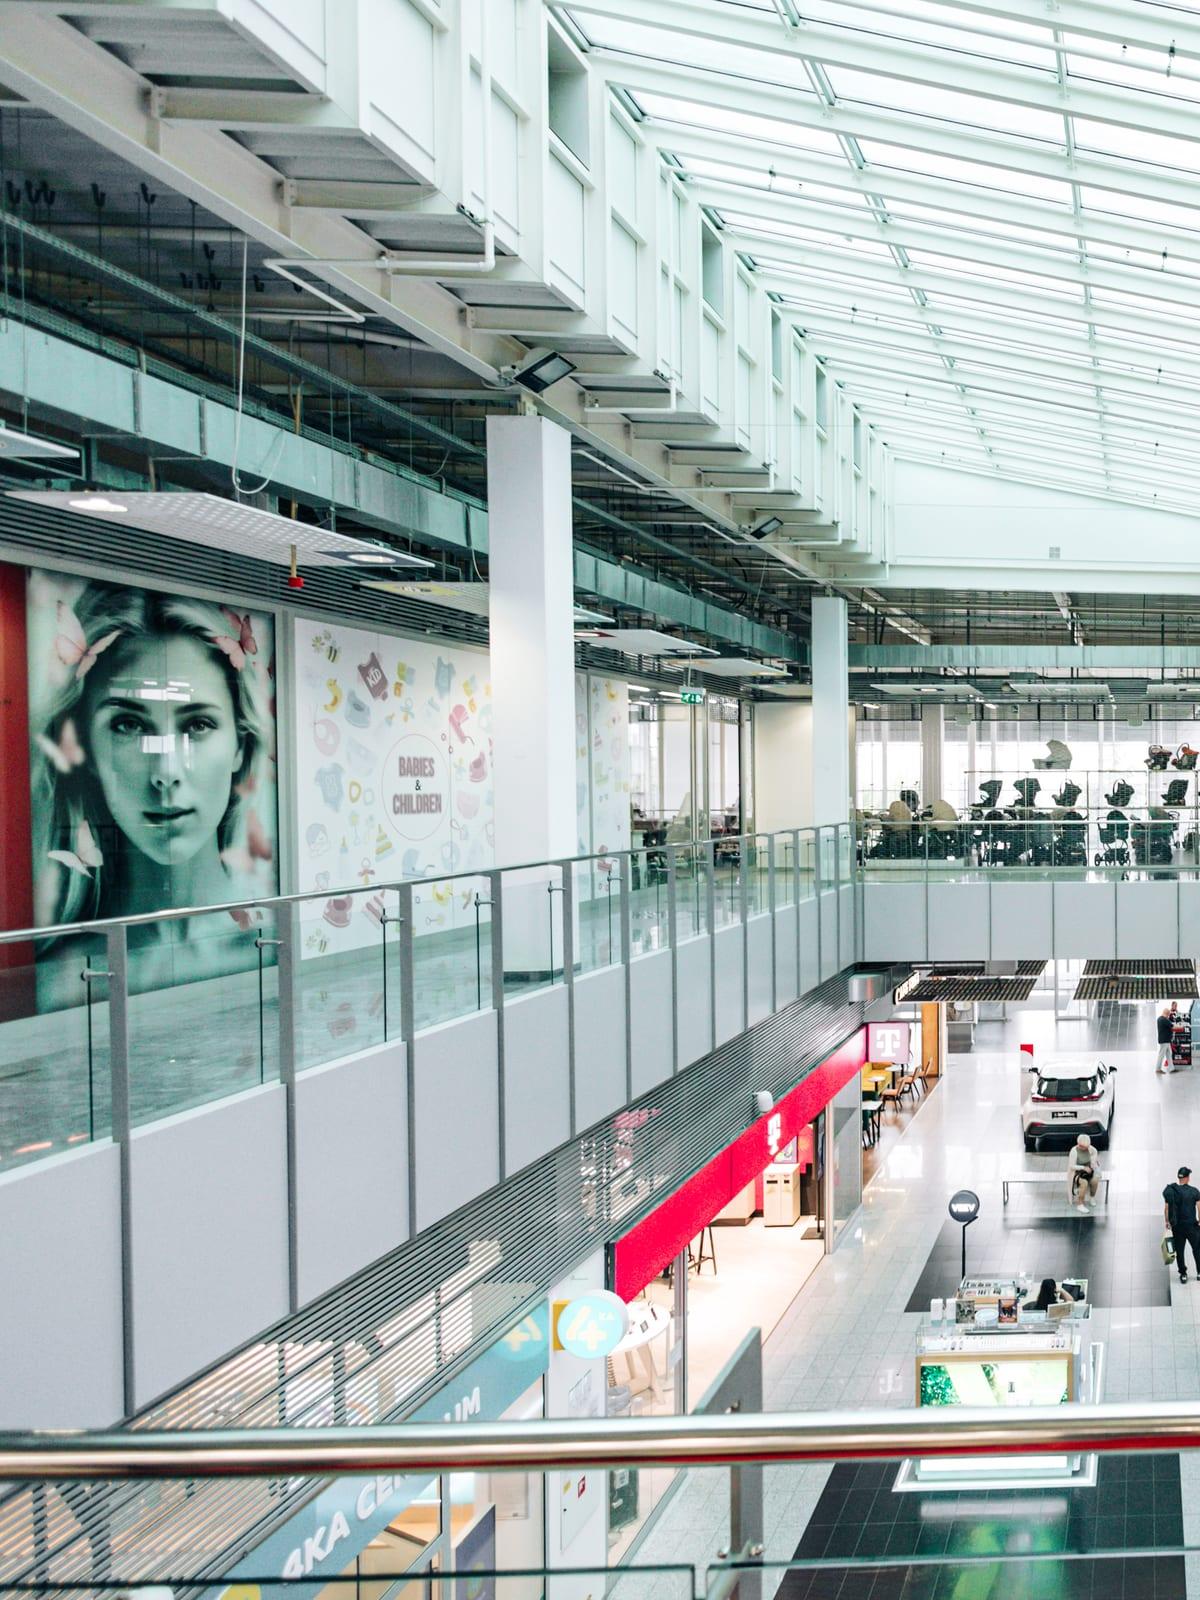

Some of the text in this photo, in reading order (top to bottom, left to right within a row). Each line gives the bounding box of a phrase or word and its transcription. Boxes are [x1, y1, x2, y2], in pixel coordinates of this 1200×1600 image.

[398, 756, 435, 778] BABIES
[415, 779, 422, 791] &
[392, 793, 442, 815] CHILDREN
